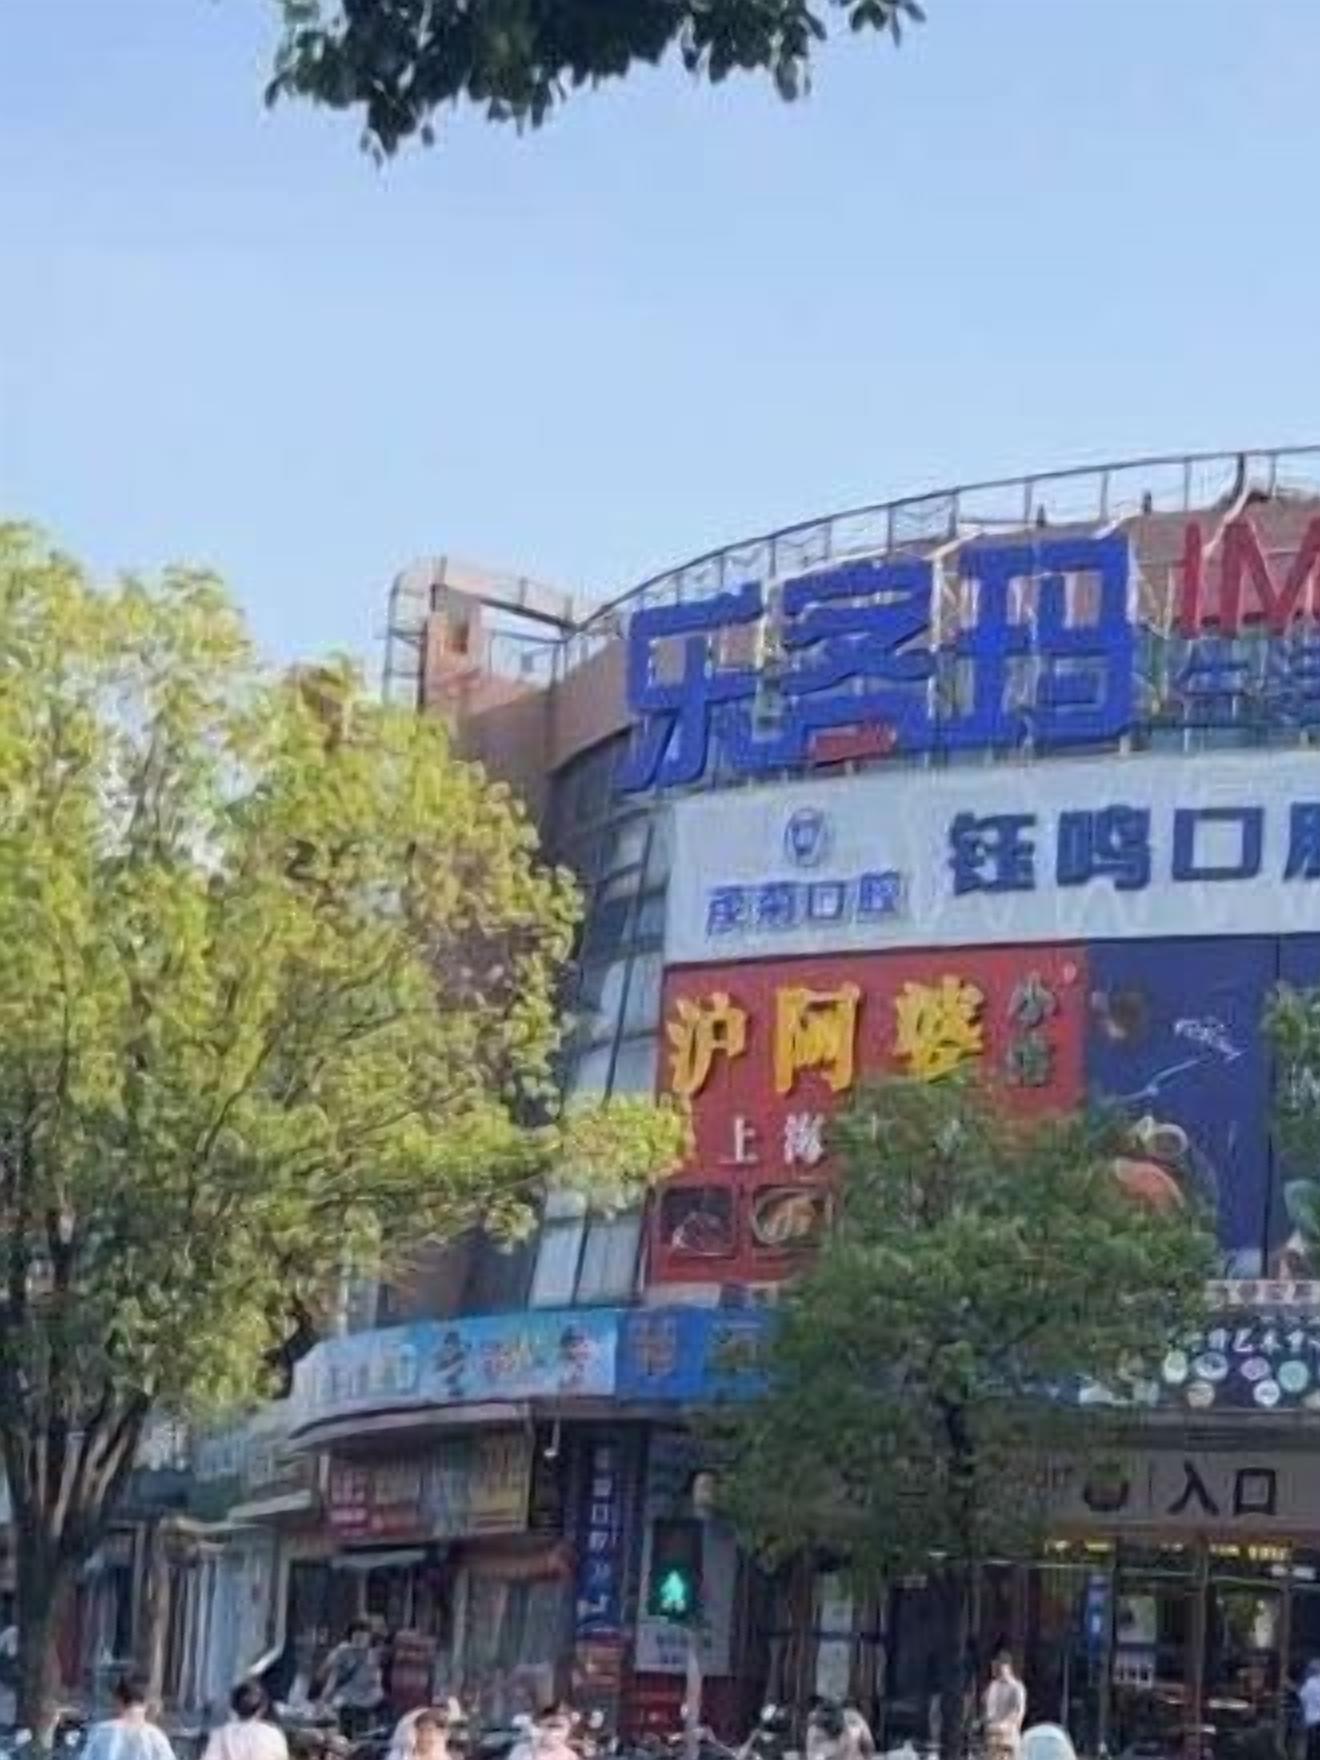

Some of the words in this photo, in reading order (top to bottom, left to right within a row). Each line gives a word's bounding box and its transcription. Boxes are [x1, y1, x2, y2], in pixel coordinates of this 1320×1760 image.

[617, 532, 1138, 792] 乐客玛
[667, 974, 985, 1098] 沪阿婆
[1168, 1460, 1278, 1517] 入口
